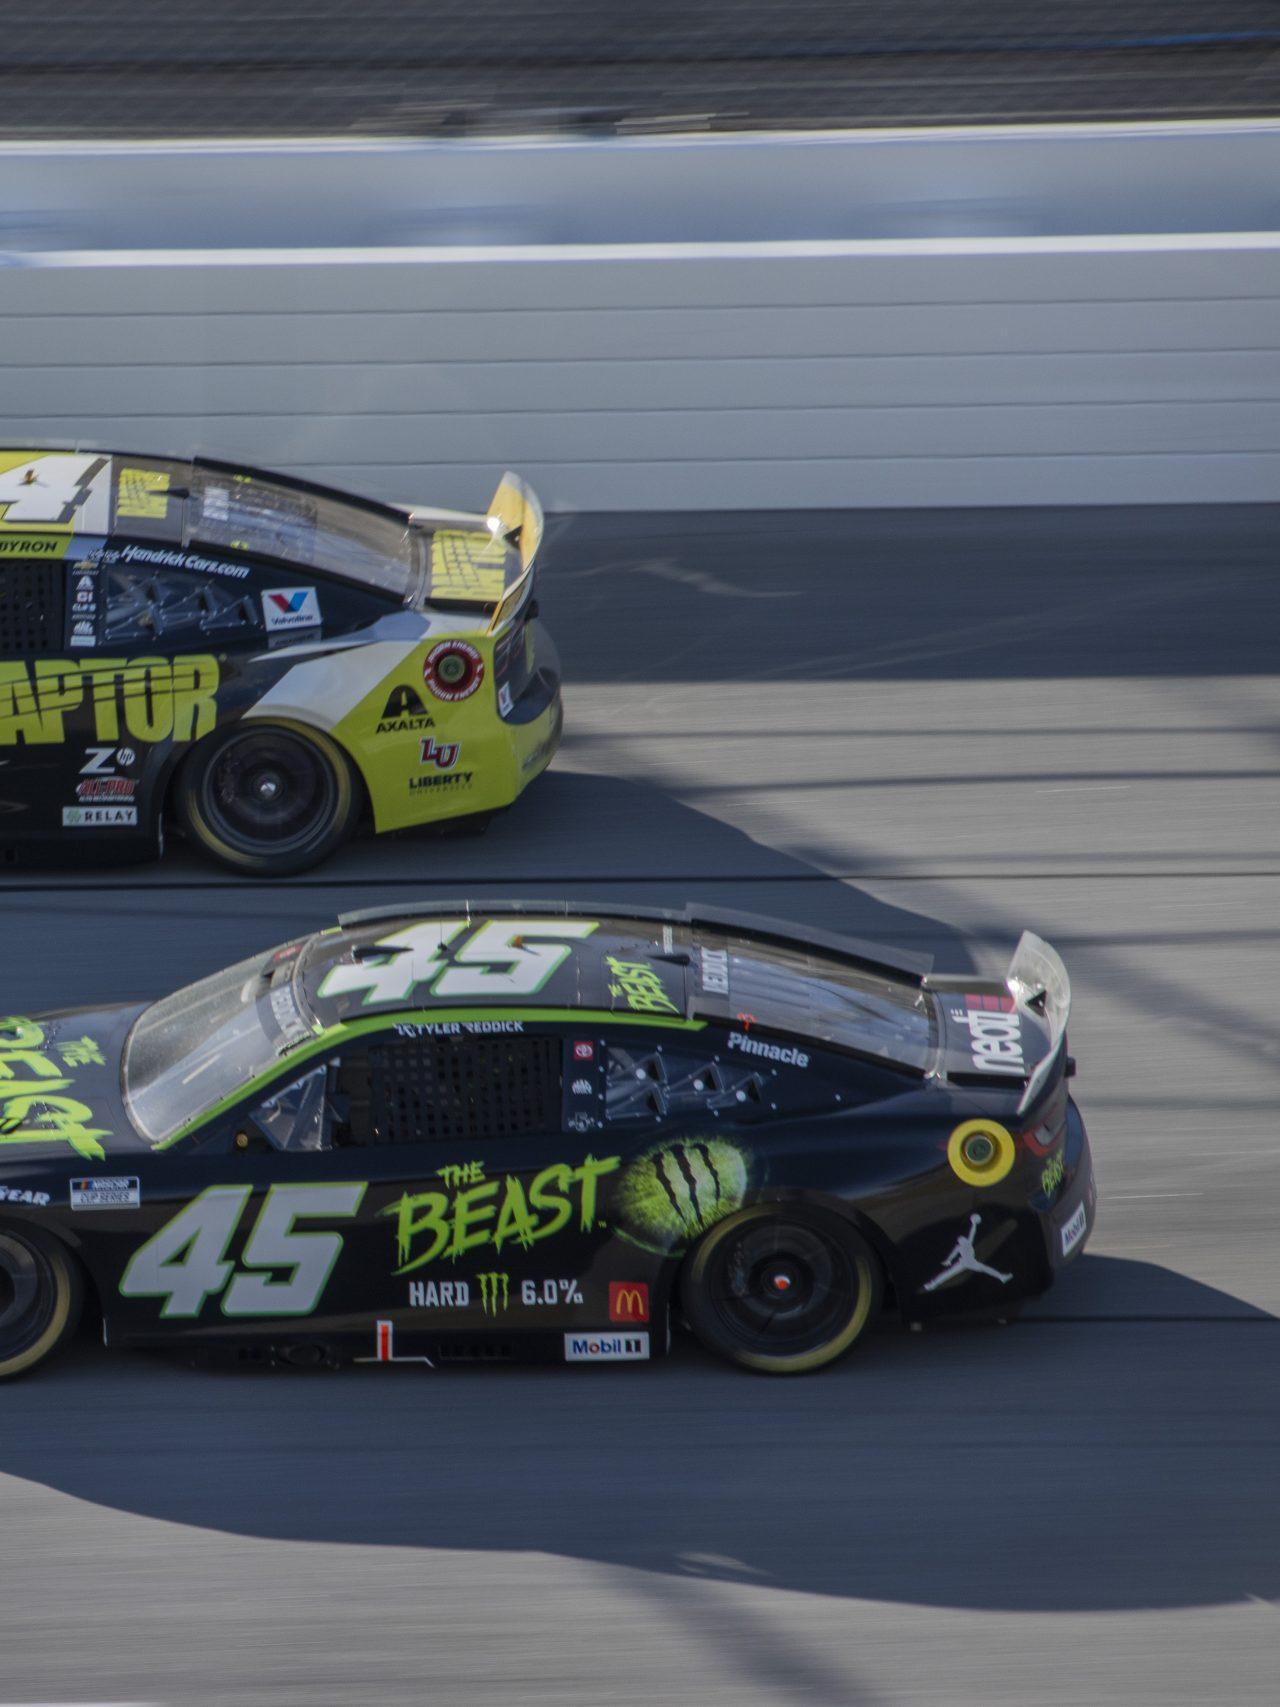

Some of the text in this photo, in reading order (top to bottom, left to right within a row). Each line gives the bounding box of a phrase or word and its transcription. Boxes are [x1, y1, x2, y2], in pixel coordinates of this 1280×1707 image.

[376, 717, 436, 734] AXALTA
[78, 747, 117, 774] Z
[420, 736, 461, 769] LU
[409, 772, 472, 790] LIBERTY
[84, 810, 134, 821] RELAY
[317, 919, 599, 1006] 45
[416, 1021, 524, 1035] TYLER REDDICK
[728, 1031, 810, 1068] Pinnacle
[436, 1160, 486, 1189] THE
[375, 1153, 621, 1276] BEAST
[119, 1181, 369, 1319] 45
[409, 1279, 585, 1307] HARD 6.0%
[572, 1339, 622, 1355] Mobil
